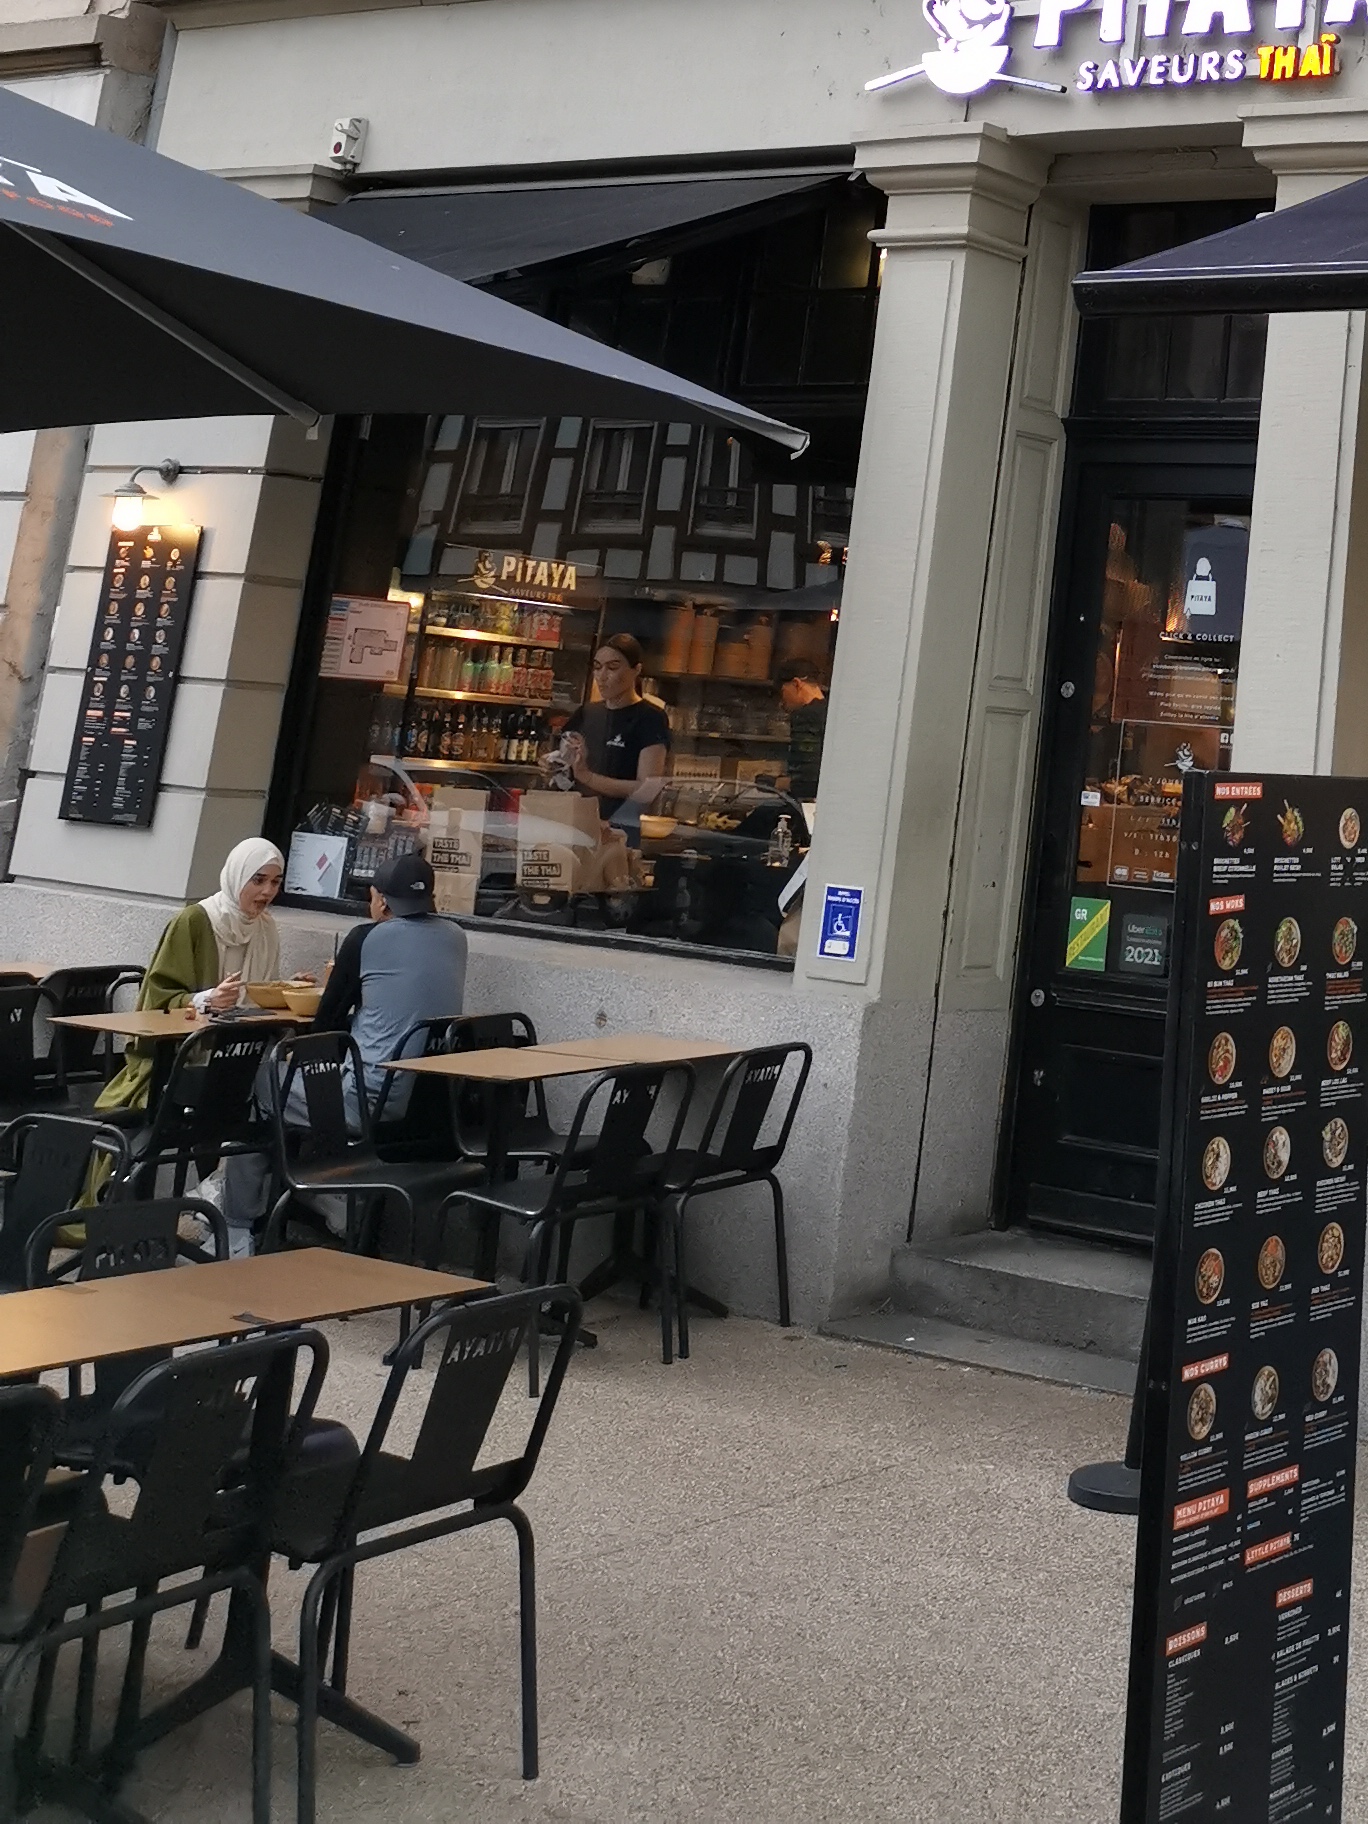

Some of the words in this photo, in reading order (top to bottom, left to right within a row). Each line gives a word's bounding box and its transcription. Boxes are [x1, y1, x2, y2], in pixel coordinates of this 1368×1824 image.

[1076, 49, 1247, 92] SAVEURS
[500, 556, 577, 591] PITAYA
[1196, 633, 1235, 643] COLLECT
[1215, 786, 1230, 796] NOS
[434, 838, 459, 850] TASTE
[1209, 900, 1224, 911] NOS
[1225, 898, 1245, 909] WOKS
[1125, 945, 1162, 965] 2021
[1183, 1363, 1198, 1379] NOS
[1176, 1503, 1197, 1519] MENU
[1197, 1494, 1224, 1512] PITAYA
[1278, 1582, 1312, 1604] DESSERTS
[1168, 1627, 1206, 1651] BOISSONS
